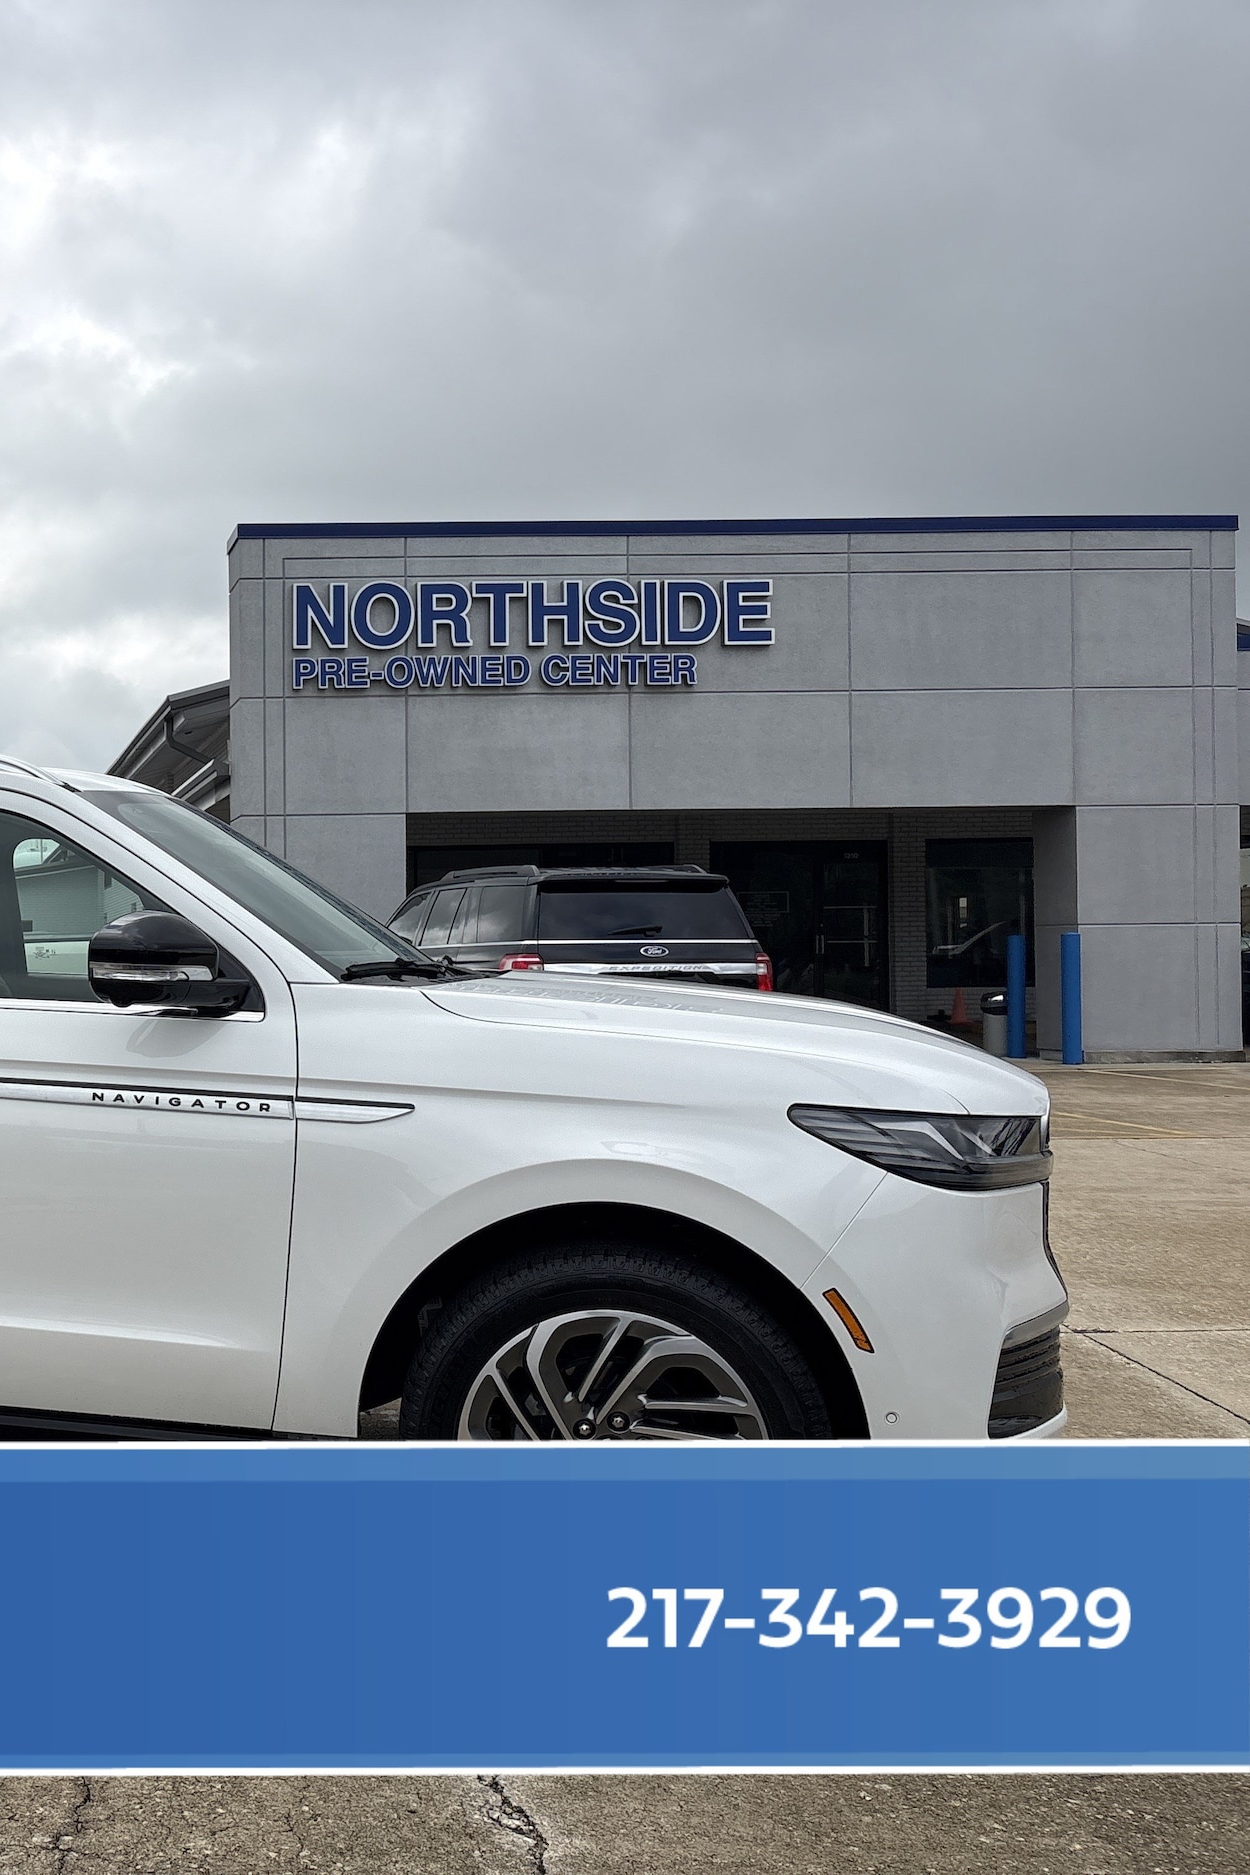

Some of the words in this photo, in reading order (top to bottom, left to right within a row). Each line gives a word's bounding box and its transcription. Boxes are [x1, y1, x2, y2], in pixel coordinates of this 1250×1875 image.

[292, 578, 776, 650] NORTHSIDE
[292, 654, 532, 690] PRE-OWNED
[541, 653, 698, 687] CENTER
[91, 1091, 272, 1113] NAVIGATOR
